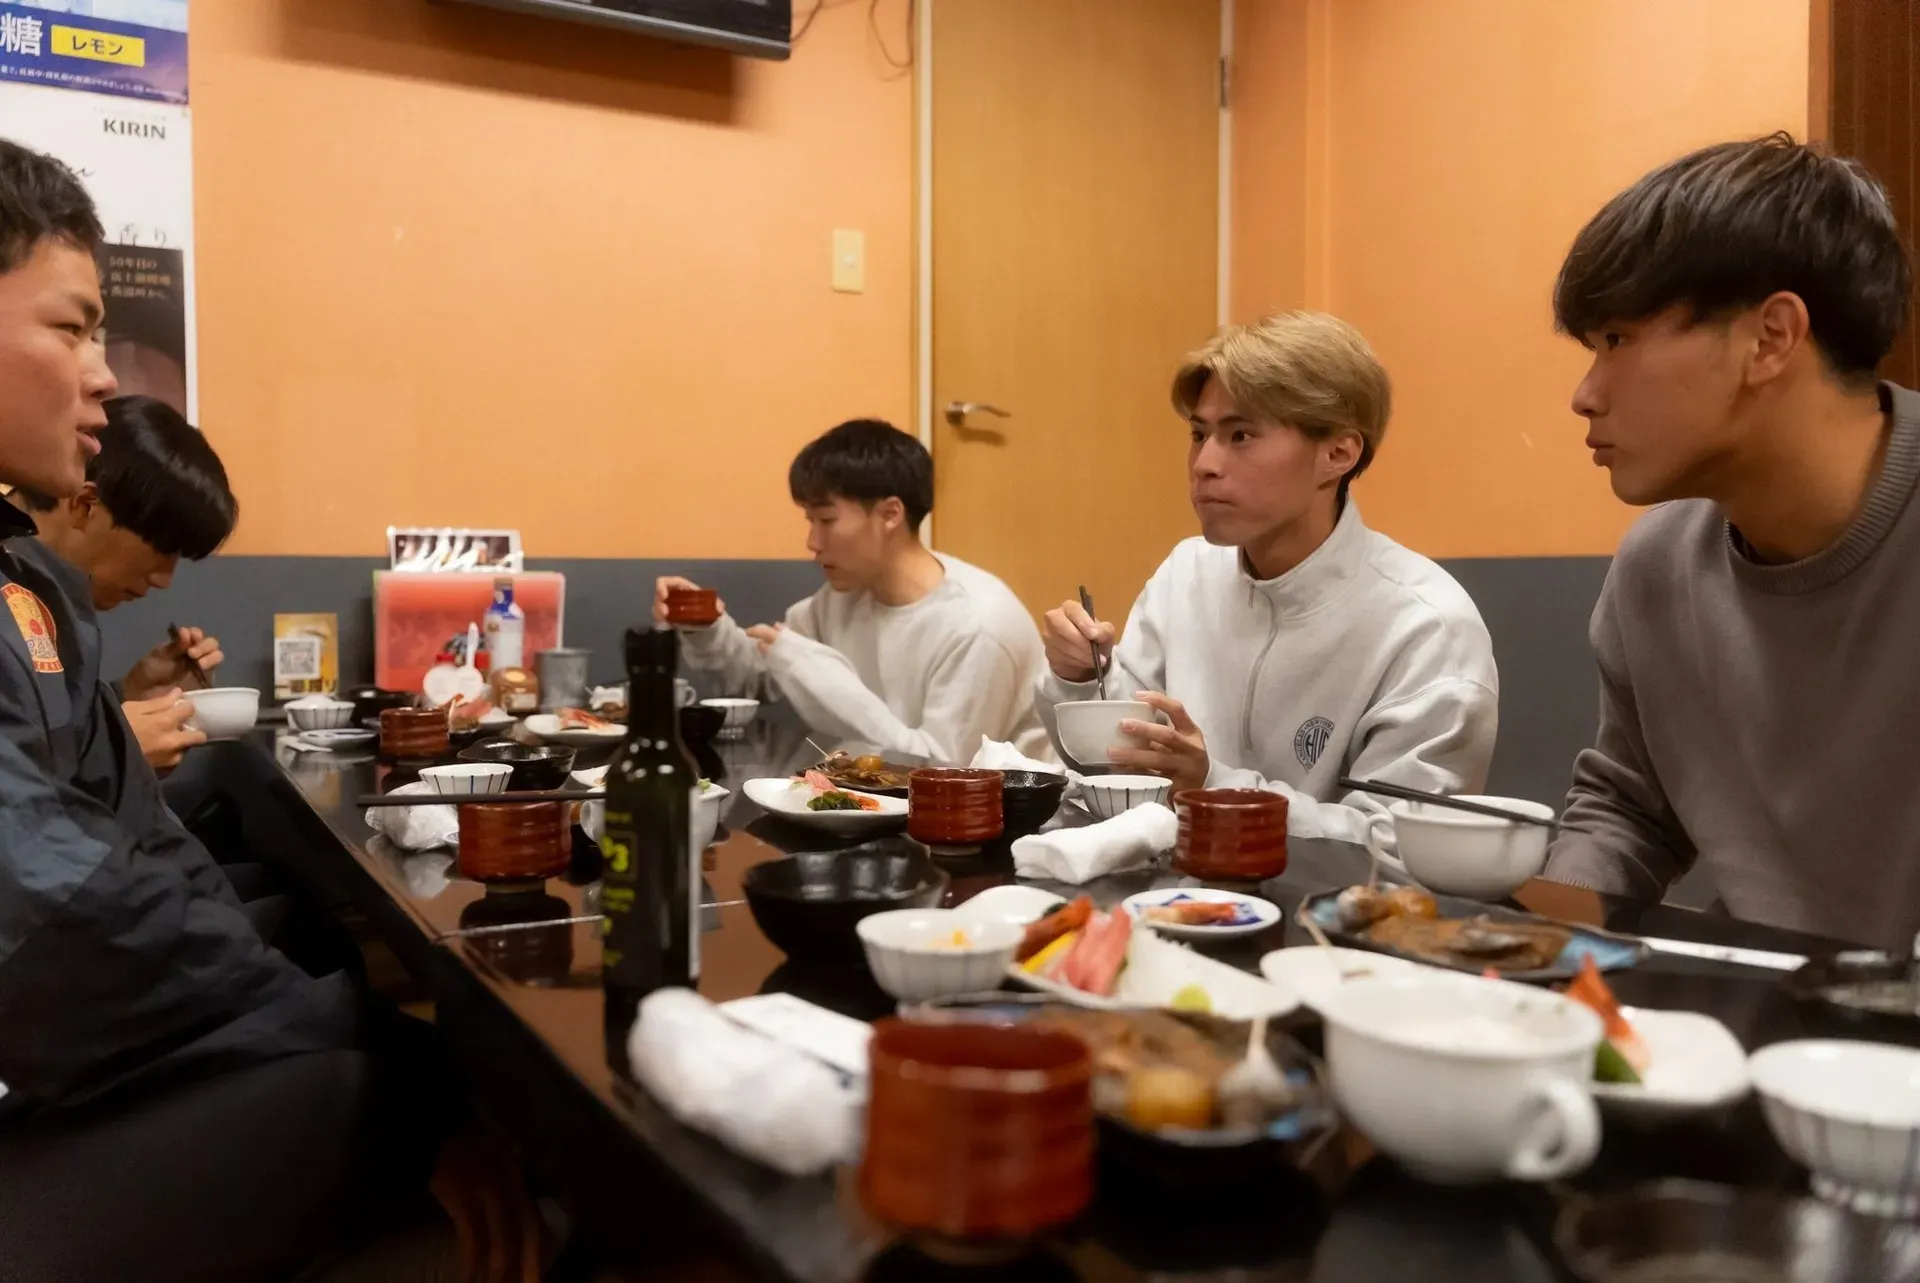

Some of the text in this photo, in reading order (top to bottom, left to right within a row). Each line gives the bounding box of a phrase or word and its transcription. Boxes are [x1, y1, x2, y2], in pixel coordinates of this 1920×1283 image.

[0, 12, 43, 57] 糖
[72, 35, 124, 57] レモン
[103, 118, 166, 141] KIRIN
